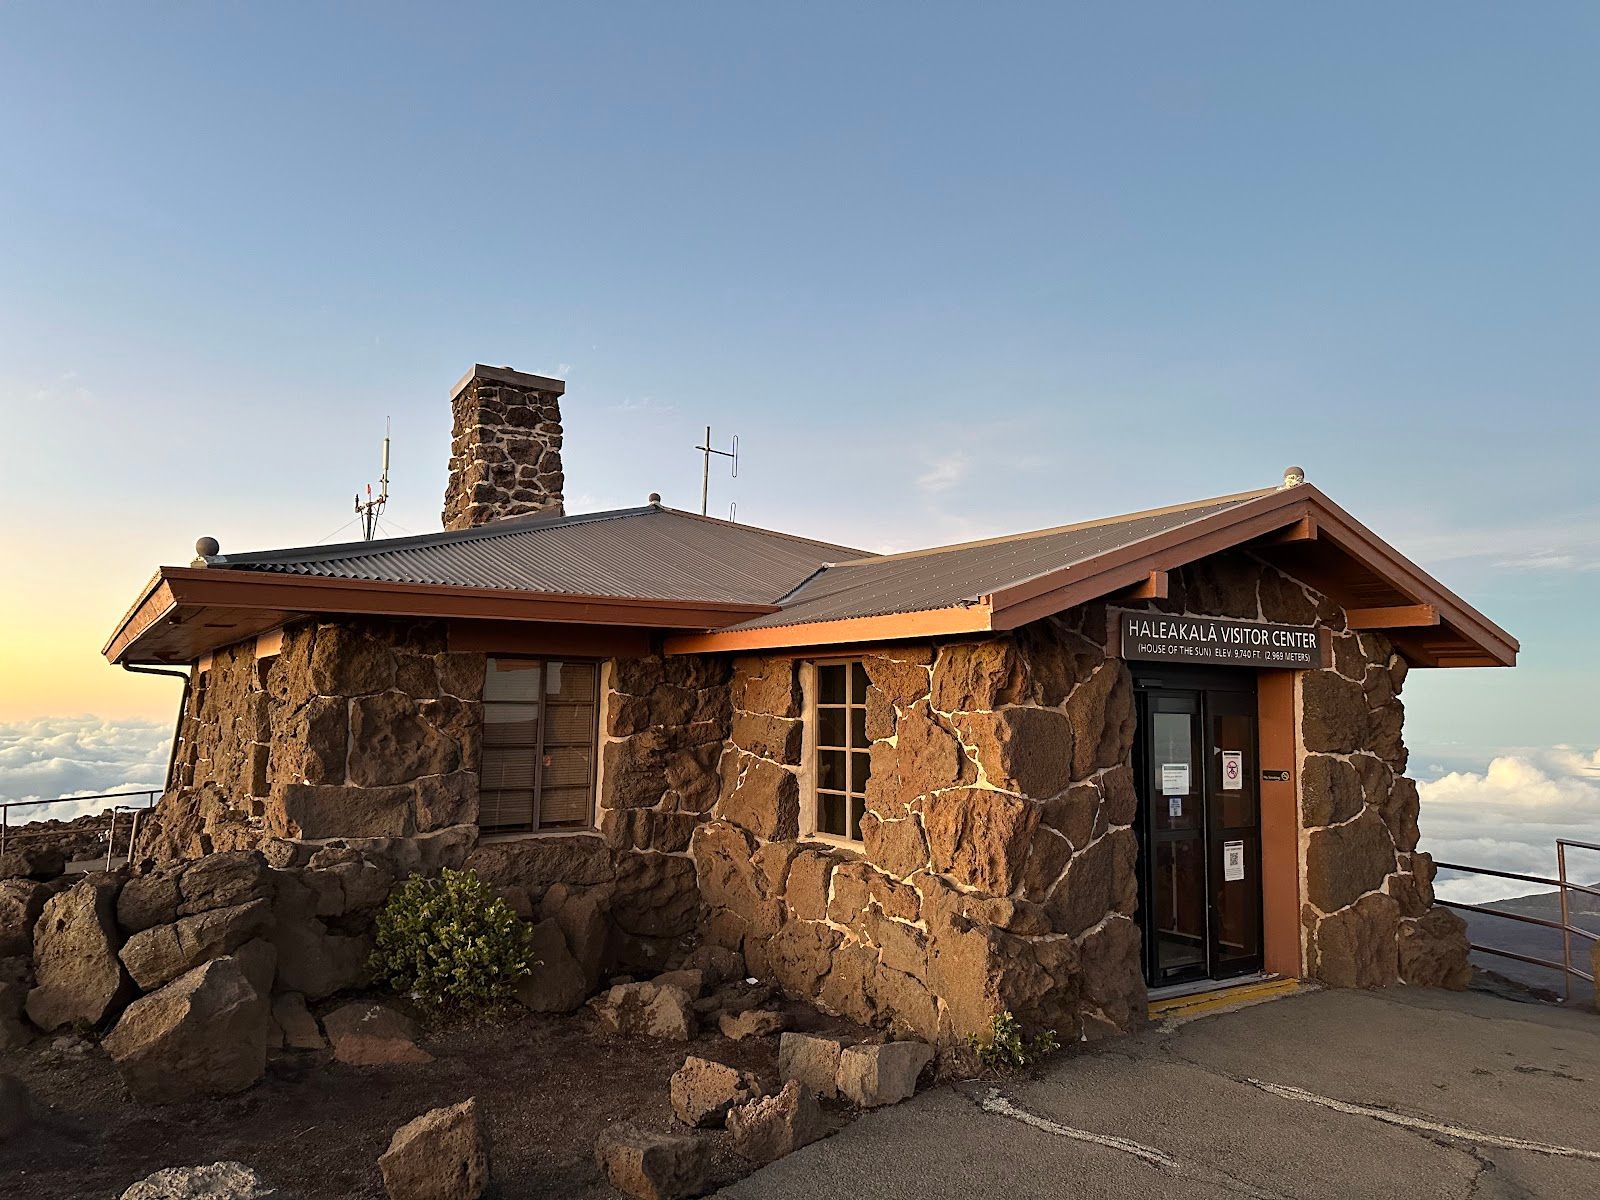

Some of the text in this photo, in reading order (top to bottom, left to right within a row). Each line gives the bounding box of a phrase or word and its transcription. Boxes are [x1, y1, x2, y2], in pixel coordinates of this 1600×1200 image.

[1129, 619, 1317, 648] HALEAKALĀ VISITOR CENTER
[1138, 643, 1166, 654] (HOUSE
[1168, 645, 1178, 654] OF
[1179, 646, 1194, 656] THE
[1195, 646, 1212, 657] SUN)
[1215, 648, 1232, 658] ELEV.
[1234, 649, 1251, 659] 9,740
[1252, 650, 1261, 659] FT.
[1284, 652, 1311, 662] METERS)
